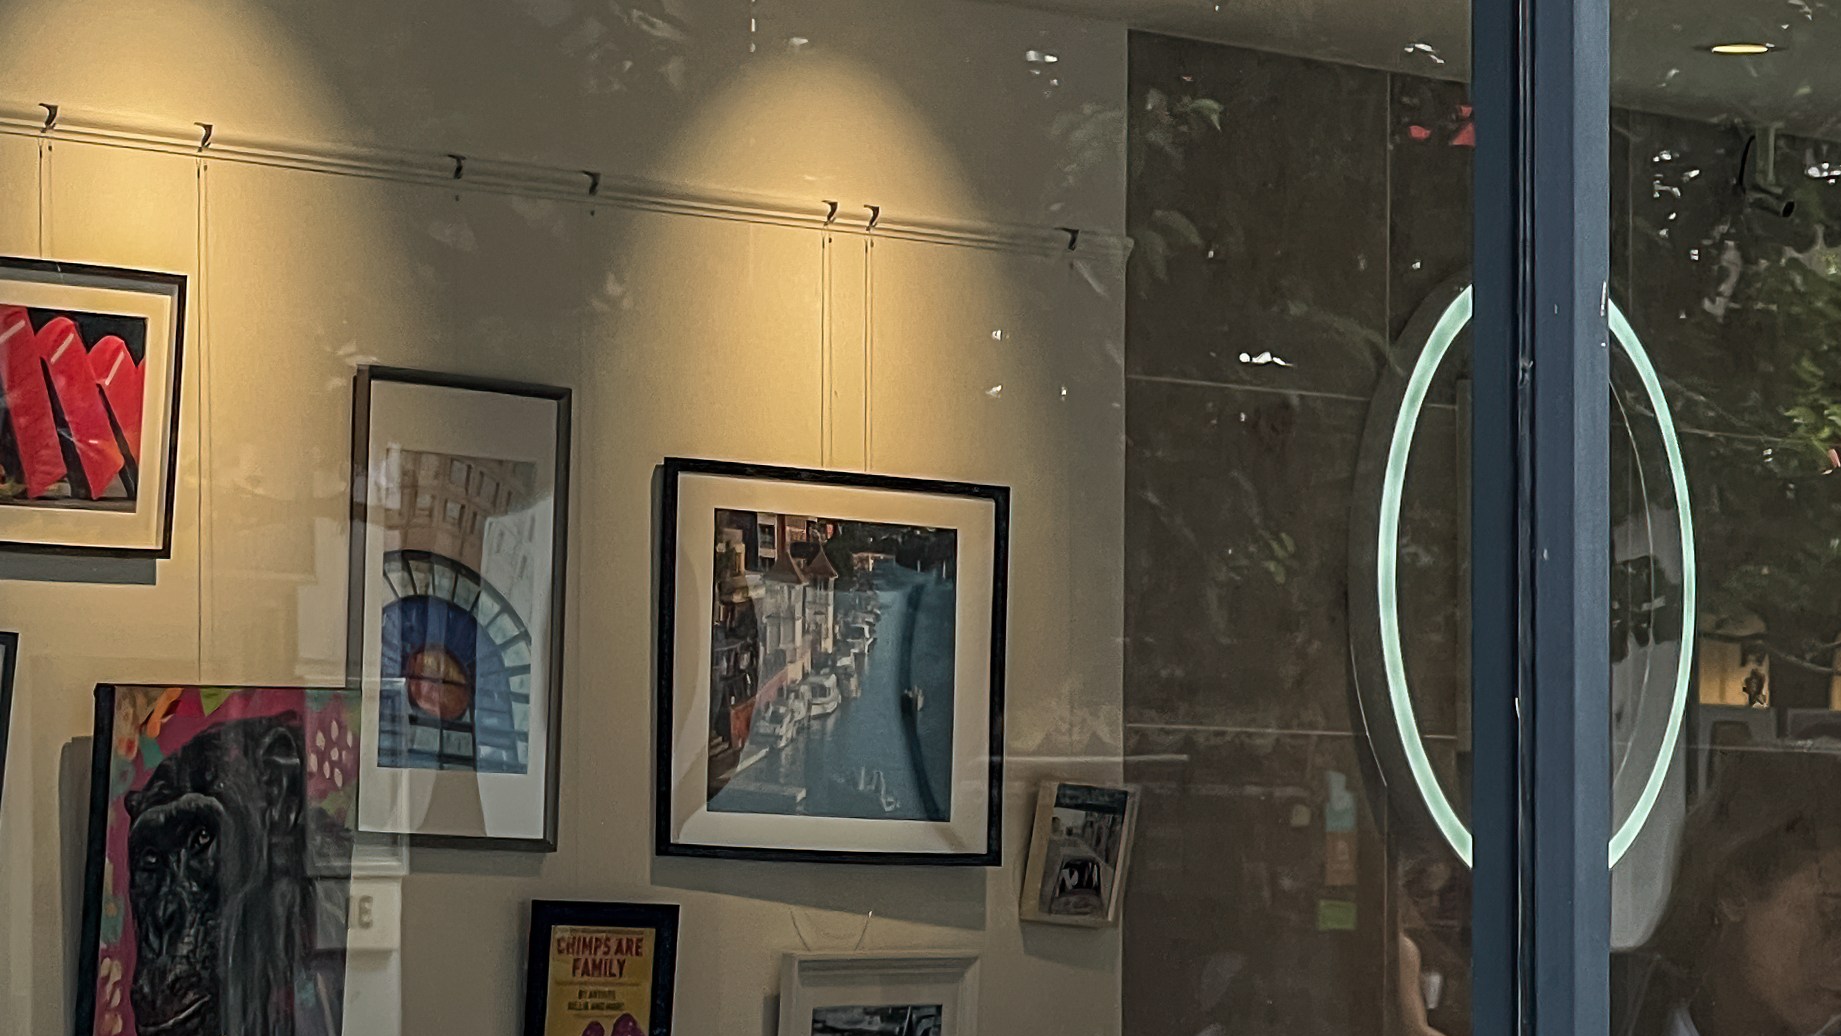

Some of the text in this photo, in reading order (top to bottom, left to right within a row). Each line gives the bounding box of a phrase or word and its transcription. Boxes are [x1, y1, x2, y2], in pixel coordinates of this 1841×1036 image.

[556, 936, 644, 957] CHIMPS ARE
[572, 958, 626, 978] FAMILY
